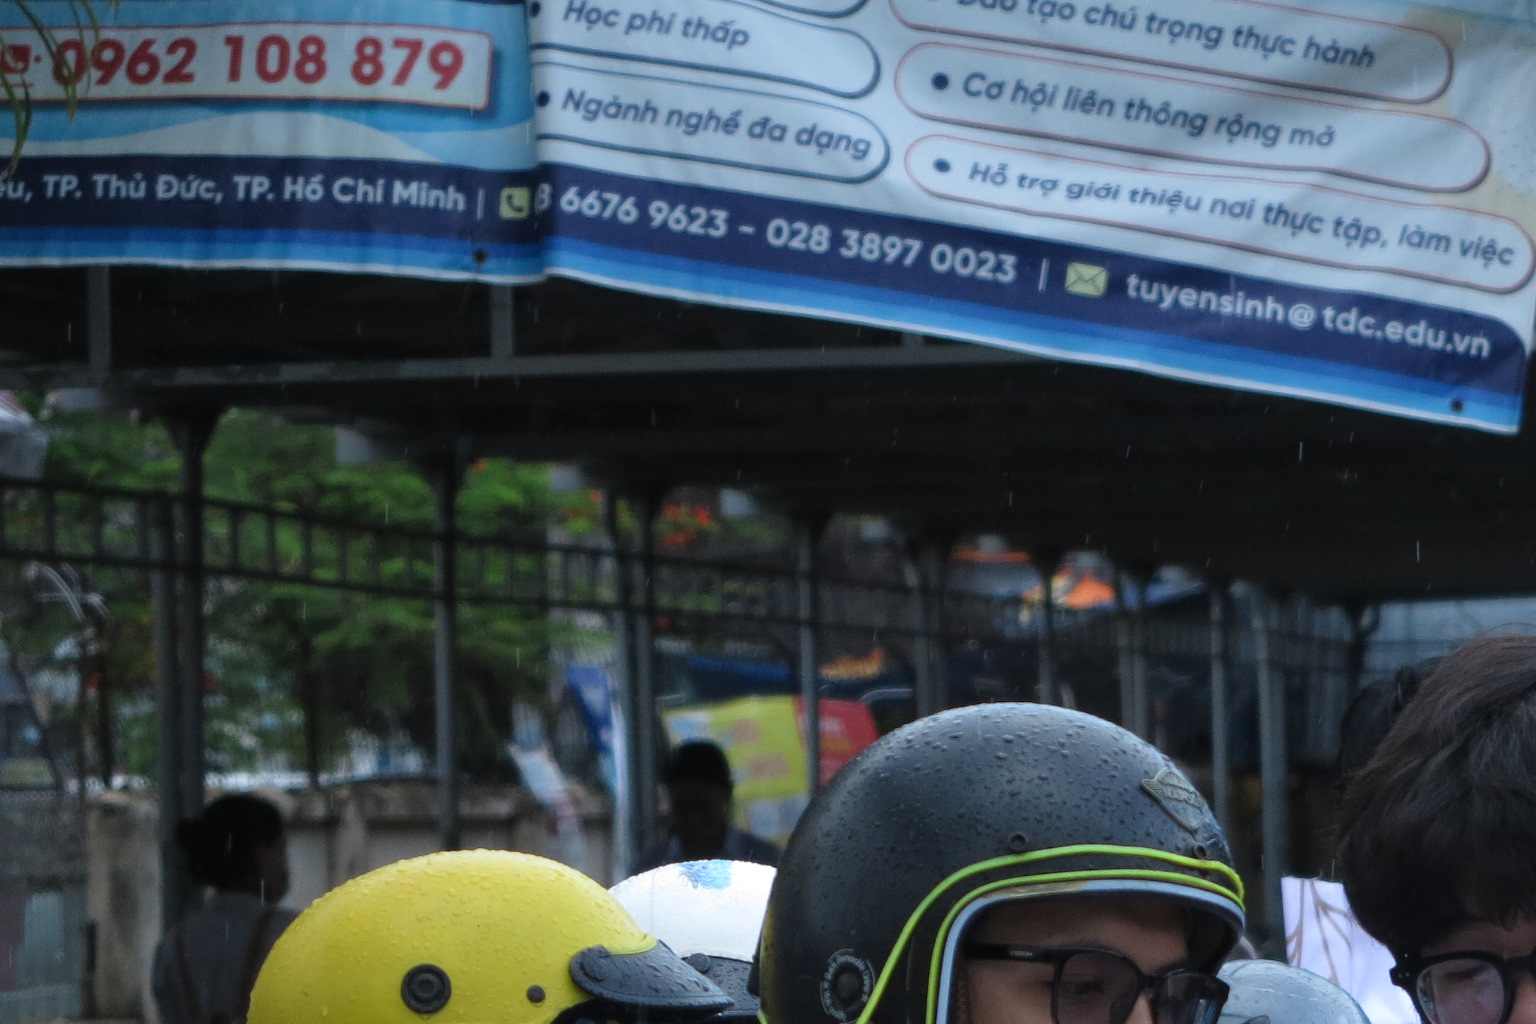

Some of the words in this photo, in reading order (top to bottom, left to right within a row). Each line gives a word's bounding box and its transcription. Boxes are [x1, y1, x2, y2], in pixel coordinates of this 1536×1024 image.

[563, 0, 619, 31] Học
[625, 9, 674, 35] phí
[682, 17, 750, 49] thấp
[1083, 4, 1138, 31] chú
[1145, 12, 1223, 50] trọng
[1232, 24, 1296, 60] thực
[1302, 34, 1377, 68] hành
[52, 37, 198, 86] 0962
[224, 34, 327, 83] 108
[350, 36, 464, 90] 879
[561, 88, 658, 123] Ngành
[664, 106, 743, 137] nghề
[746, 115, 788, 143] đa
[795, 122, 872, 161] dạng
[962, 71, 1005, 101] Cơ
[1010, 78, 1056, 113] hội
[1061, 86, 1115, 119] liên
[1123, 98, 1209, 138] thông
[1213, 113, 1282, 149] rộng
[1288, 125, 1336, 148] mở
[43, 174, 82, 199] TP.
[92, 171, 146, 199] Thủ
[156, 173, 223, 204] Đức,
[233, 175, 275, 201] TP.
[283, 173, 325, 201] Hồ
[332, 176, 386, 204] Chí
[392, 179, 467, 213] Minh
[968, 161, 1009, 187] Hỗ
[1017, 172, 1059, 198] trợ
[1065, 180, 1122, 201] giới
[1128, 186, 1202, 215] thiệu
[1208, 197, 1256, 221] nơi
[1262, 201, 1324, 238] thực
[1331, 214, 1388, 249] tập,
[1397, 222, 1451, 253] làm
[1458, 236, 1516, 268] việc
[560, 186, 639, 224] 6676
[648, 199, 729, 238] 9623
[766, 217, 831, 254] 028
[840, 228, 923, 268] 3897
[930, 243, 1018, 284] 0023
